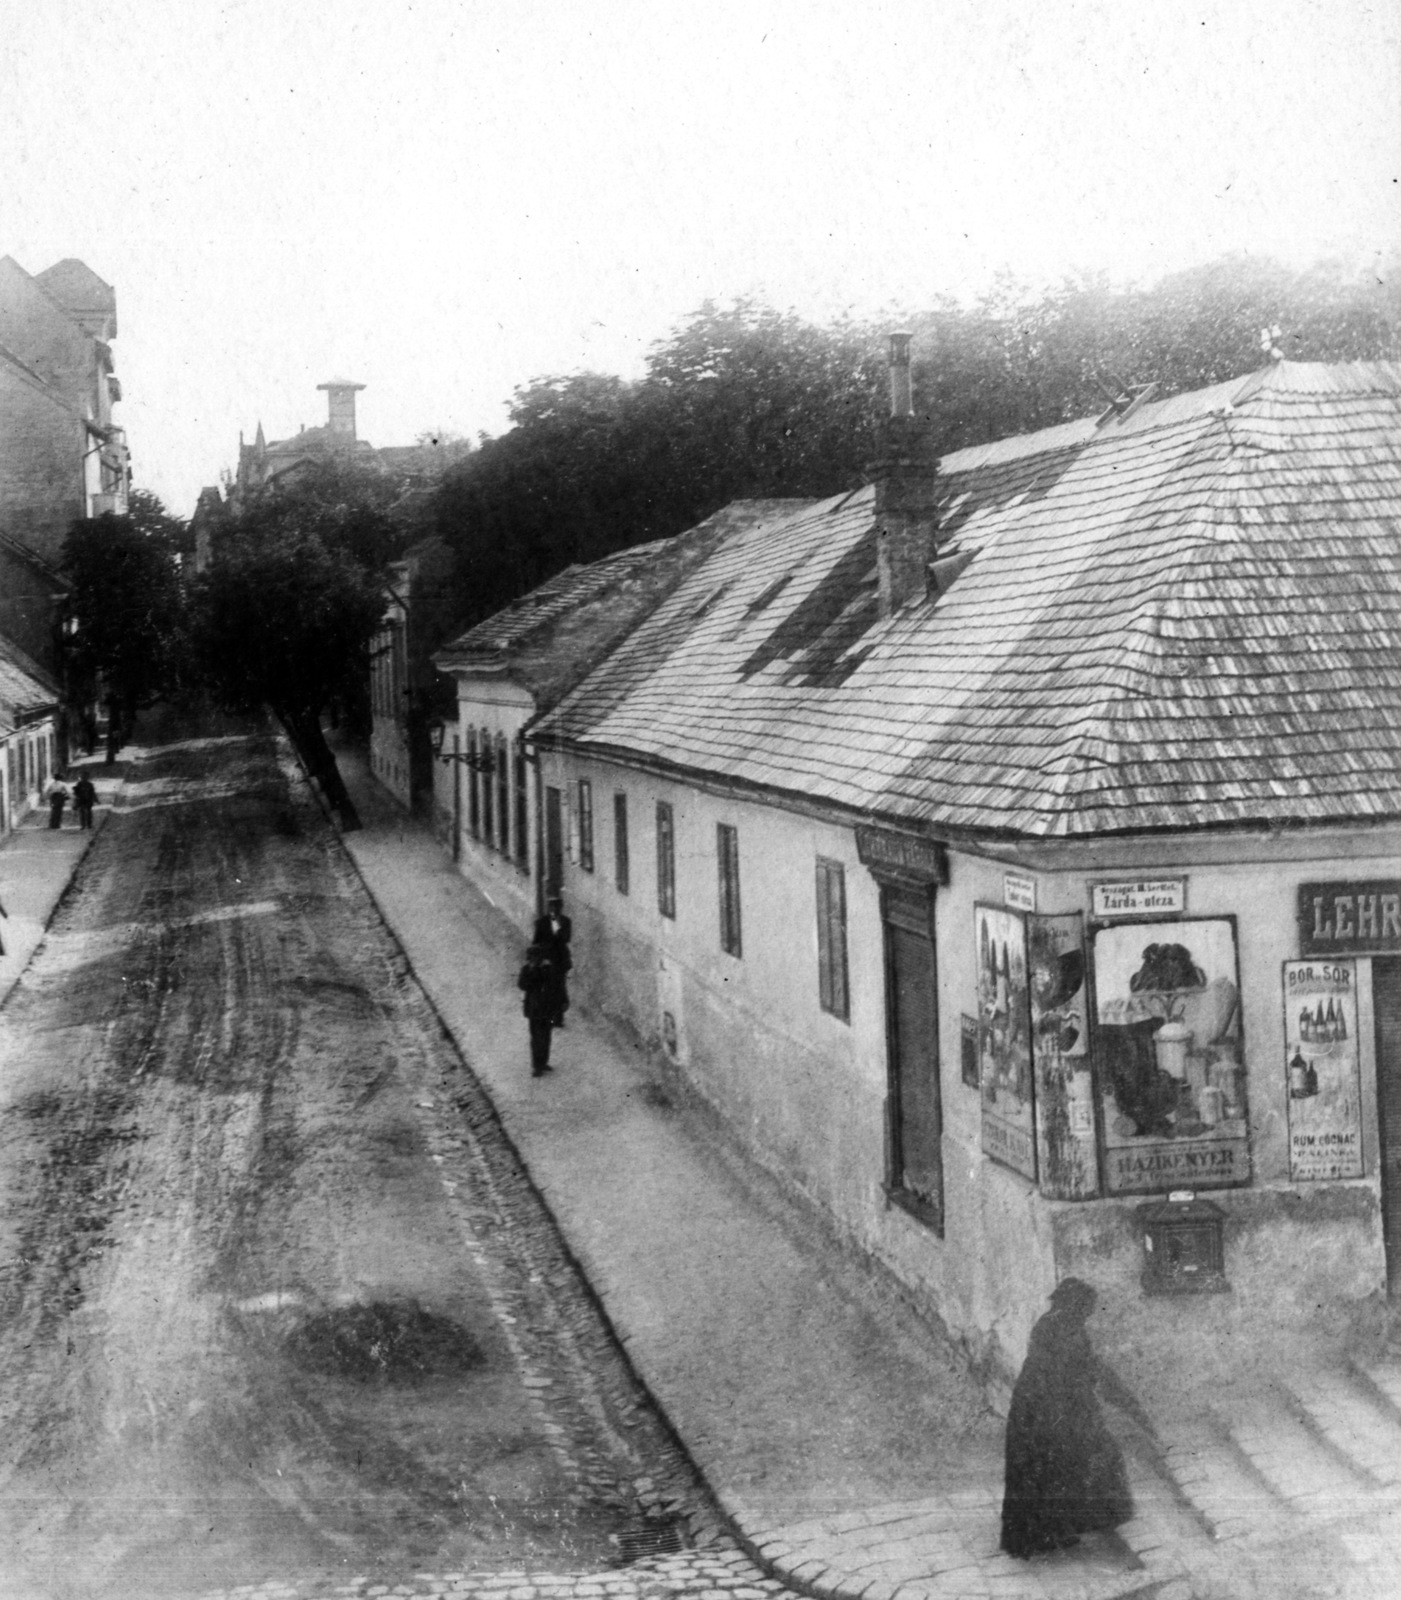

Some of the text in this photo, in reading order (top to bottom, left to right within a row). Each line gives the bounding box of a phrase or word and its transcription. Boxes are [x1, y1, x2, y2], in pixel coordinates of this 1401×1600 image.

[1313, 894, 1401, 940] LEHR
[1289, 967, 1314, 987] BOR
[1293, 1134, 1315, 1146] RUM
